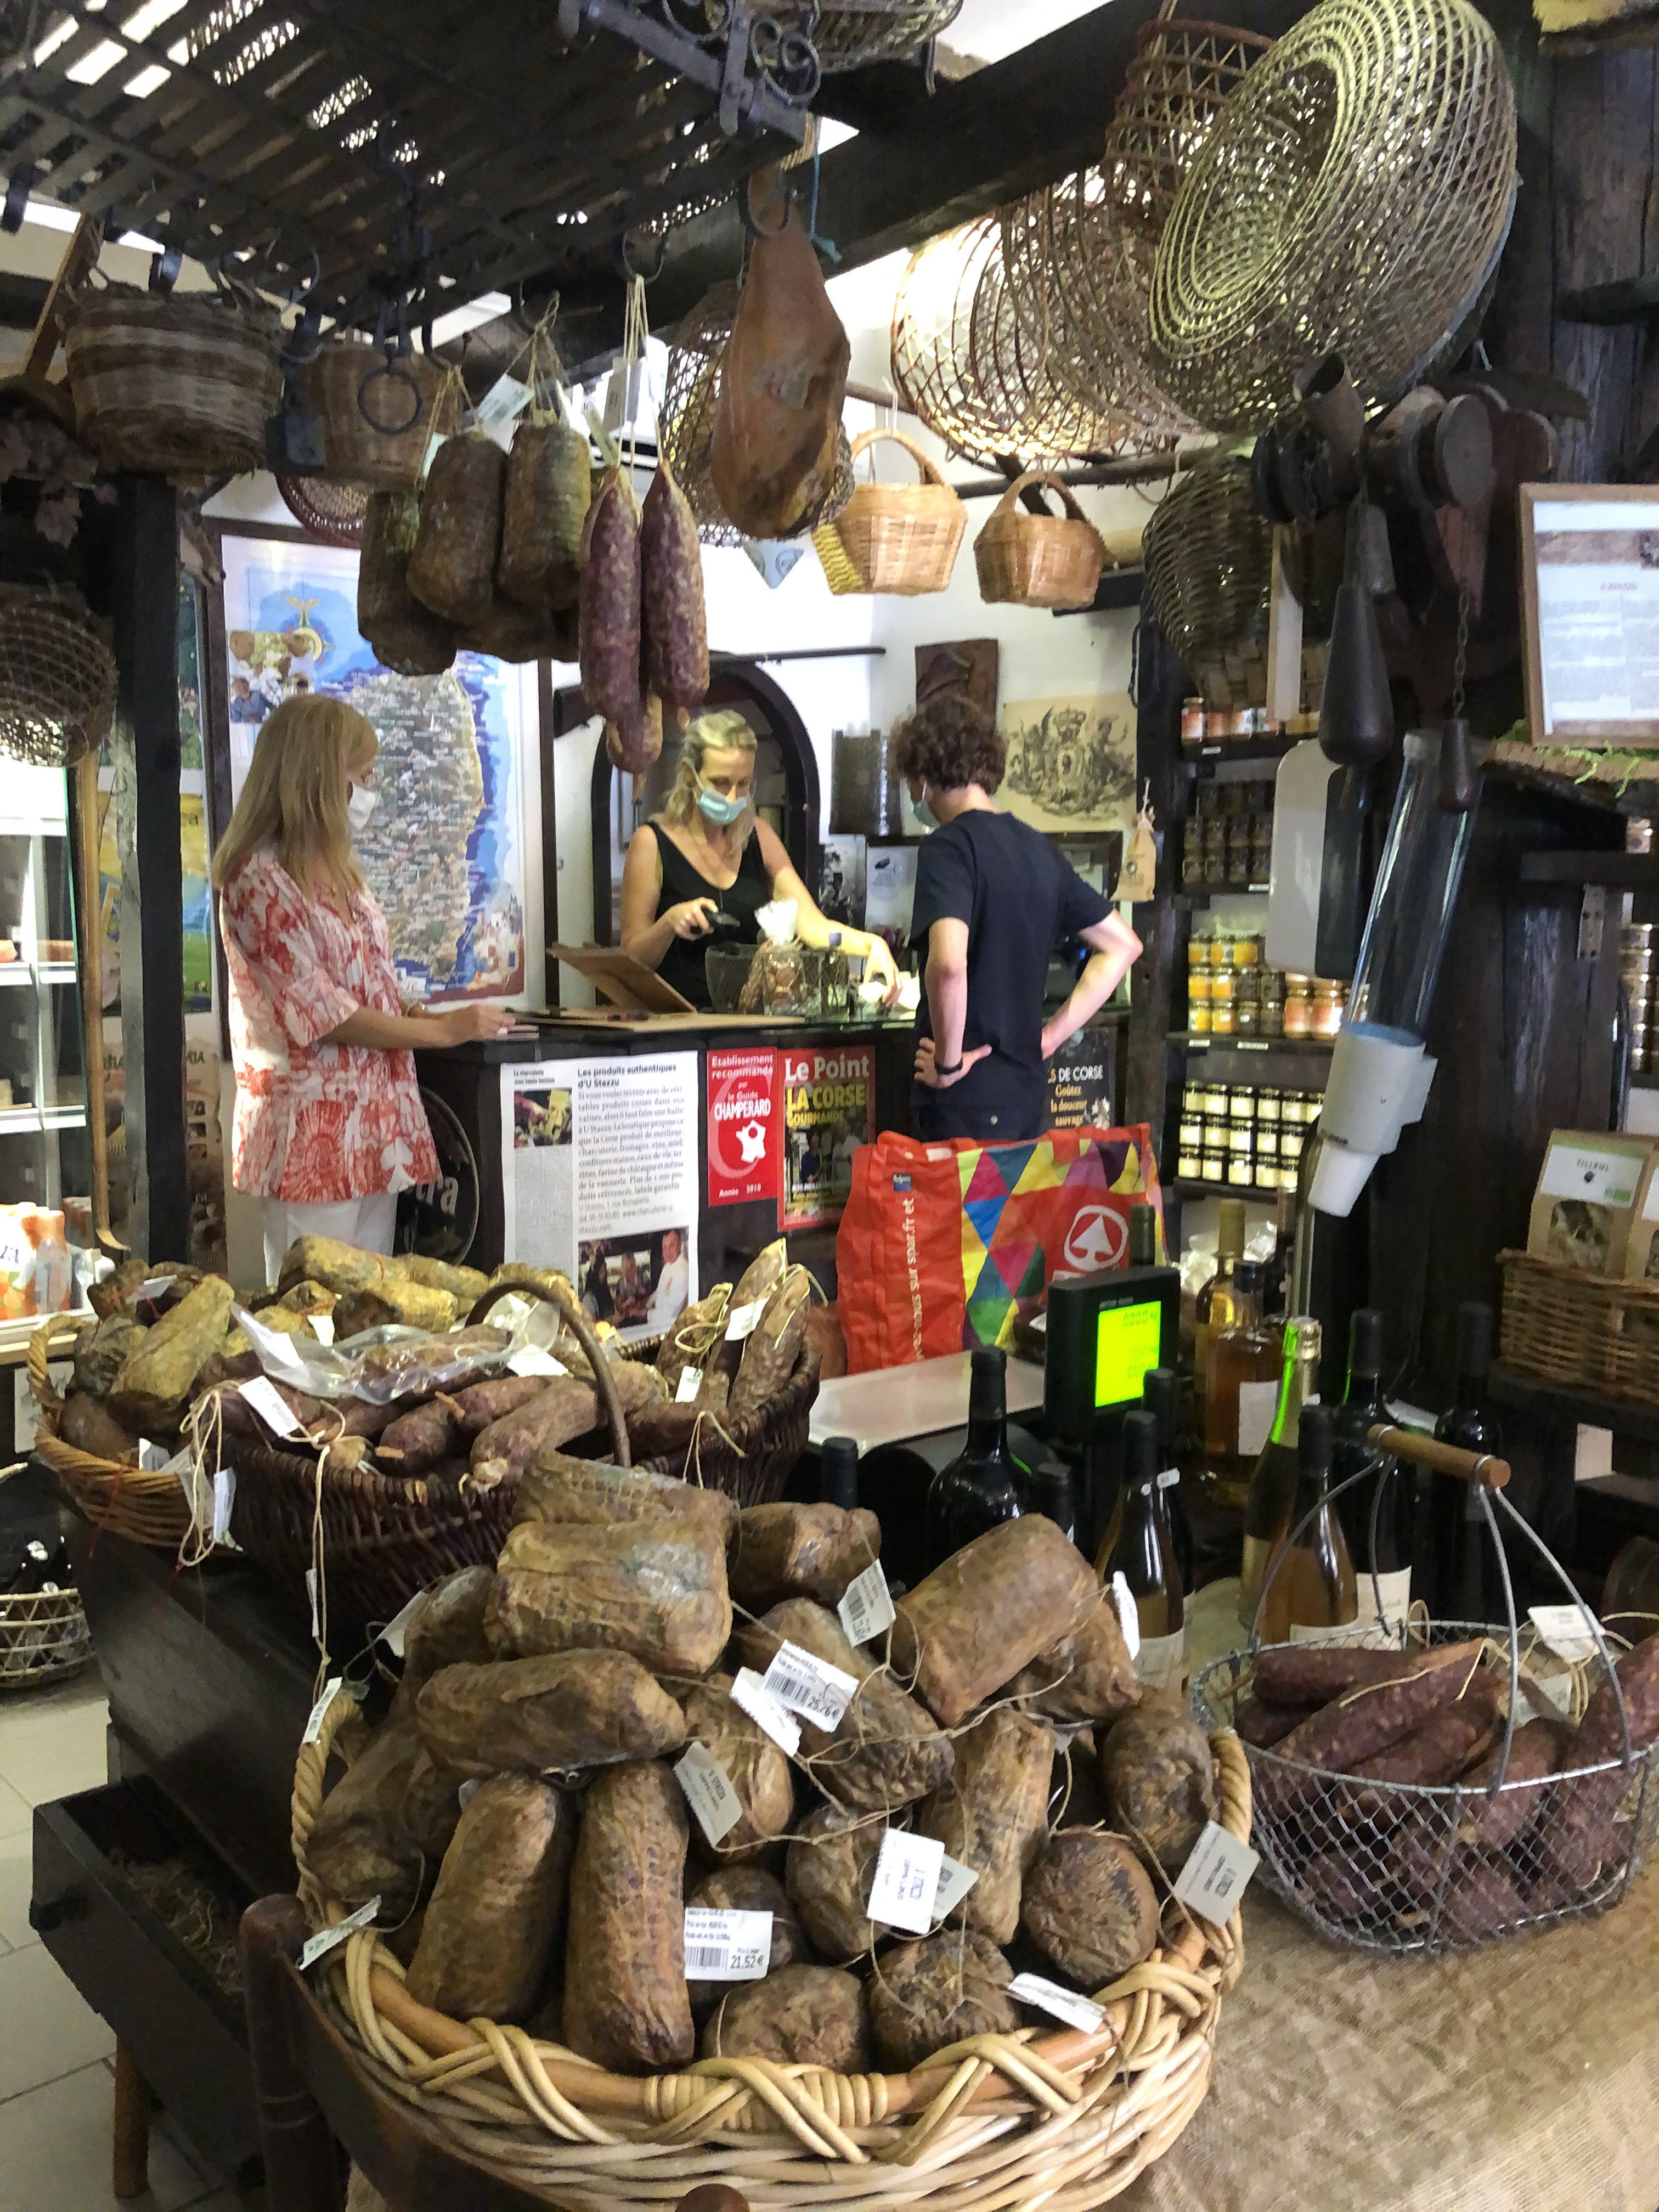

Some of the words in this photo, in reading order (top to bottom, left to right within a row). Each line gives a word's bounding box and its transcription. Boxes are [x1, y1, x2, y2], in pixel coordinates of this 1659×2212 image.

[578, 1068, 591, 1077] Les
[594, 1065, 625, 1077] produits
[627, 1063, 676, 1075] authentiques
[712, 1054, 774, 1068] Etablissement
[785, 1057, 809, 1082] Le
[814, 1052, 870, 1080] Point
[1048, 1068, 1057, 1084] S
[1059, 1067, 1070, 1082] DE
[1073, 1065, 1103, 1081] CORSE
[714, 1098, 771, 1121] CHAMPERARD
[787, 1086, 809, 1112] LA
[812, 1084, 866, 1109] CORSE
[901, 1197, 915, 1215] et
[902, 1216, 920, 1266] spar.fr
[908, 1267, 920, 1293] sur
